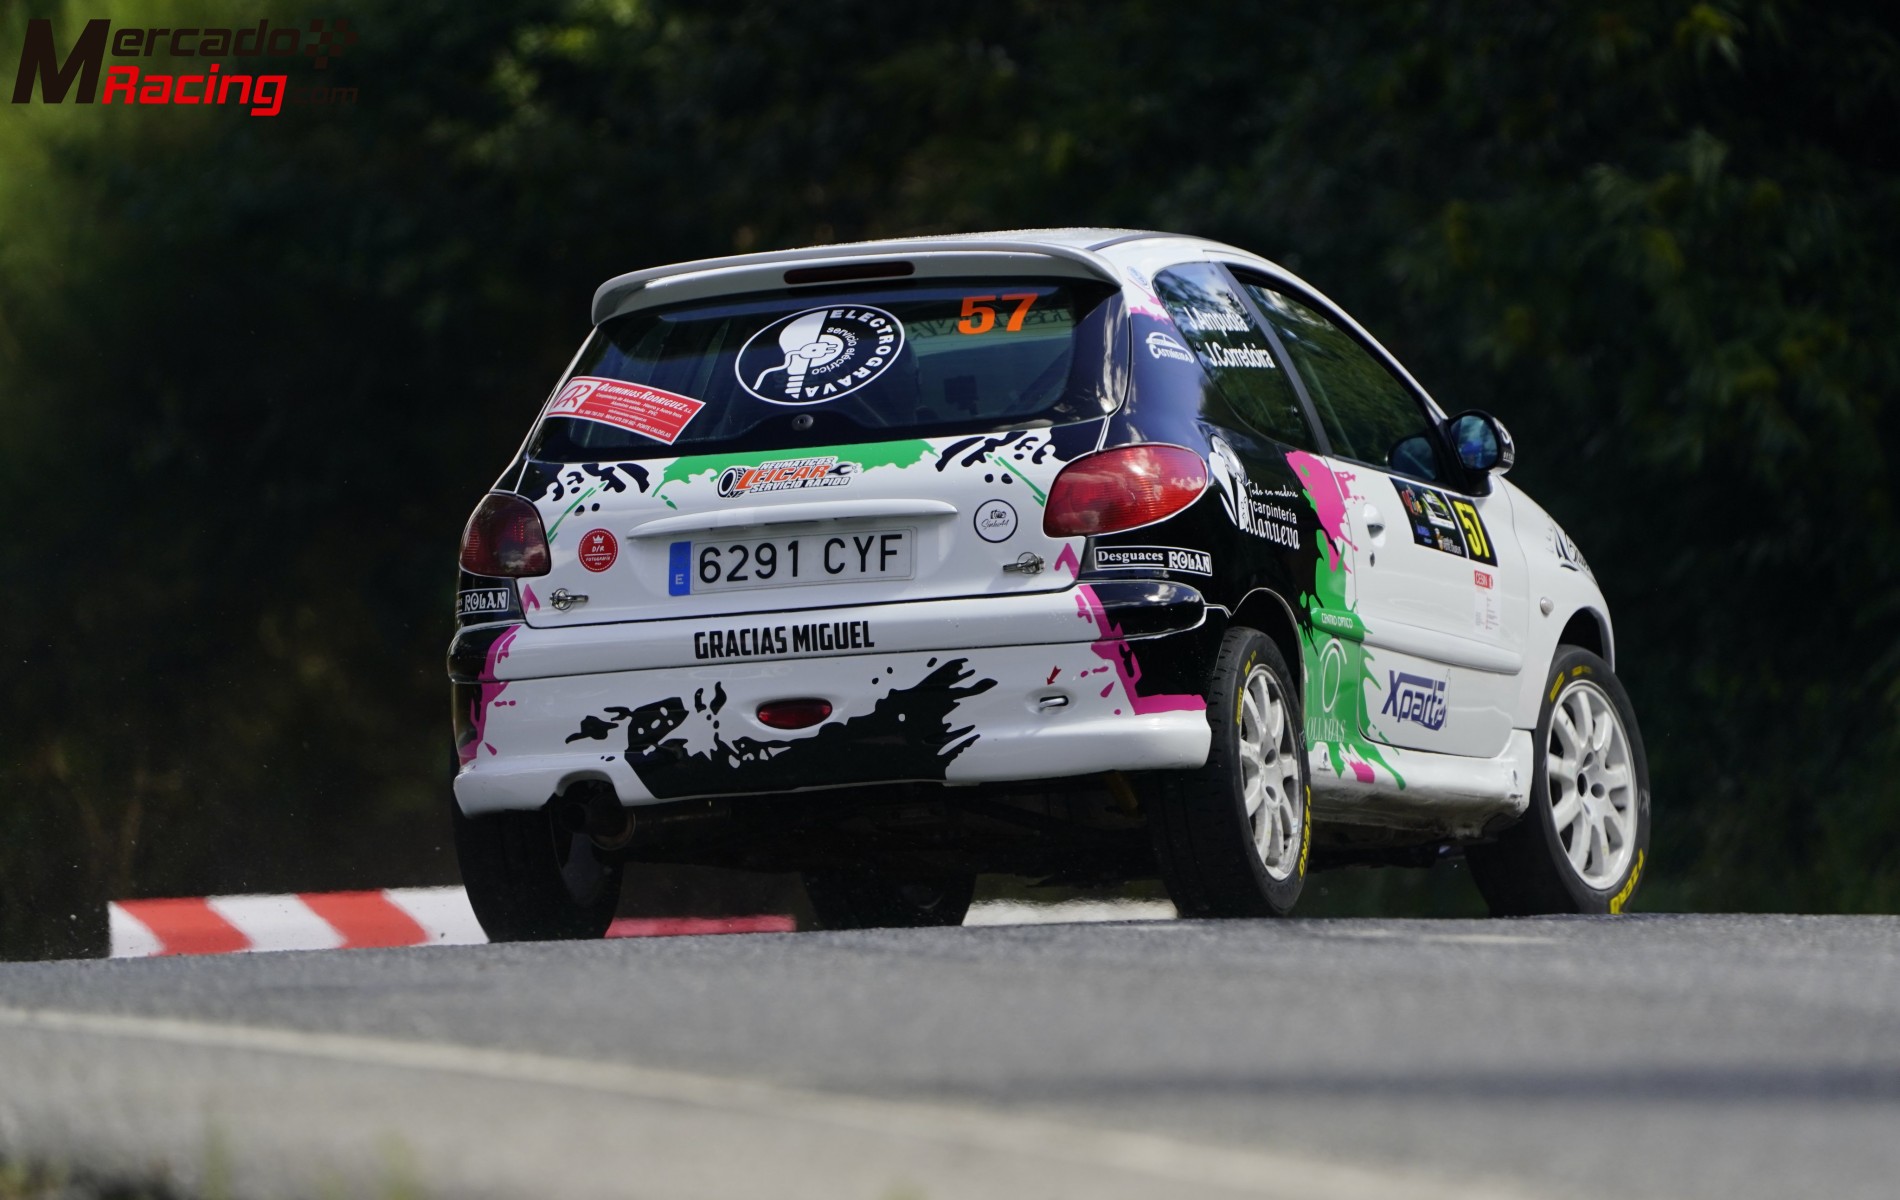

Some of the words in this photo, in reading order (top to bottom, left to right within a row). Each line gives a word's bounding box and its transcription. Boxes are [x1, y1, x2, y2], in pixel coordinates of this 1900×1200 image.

[957, 293, 1039, 335] 57
[826, 326, 859, 347] servicio
[805, 309, 895, 398] ELECTROGRAVA
[734, 465, 831, 490] LEICAR
[750, 480, 804, 493] SERVICIO
[805, 476, 851, 489] RAPIDO
[1453, 501, 1490, 558] 57
[700, 540, 799, 584] 6291
[824, 534, 903, 574] CYF
[1097, 551, 1164, 564] Desguaces
[1168, 551, 1211, 573] ROLAN
[675, 574, 684, 585] E
[464, 591, 507, 612] ROLAN
[694, 626, 788, 660] GRACIAS
[792, 620, 875, 653] MIGUEL
